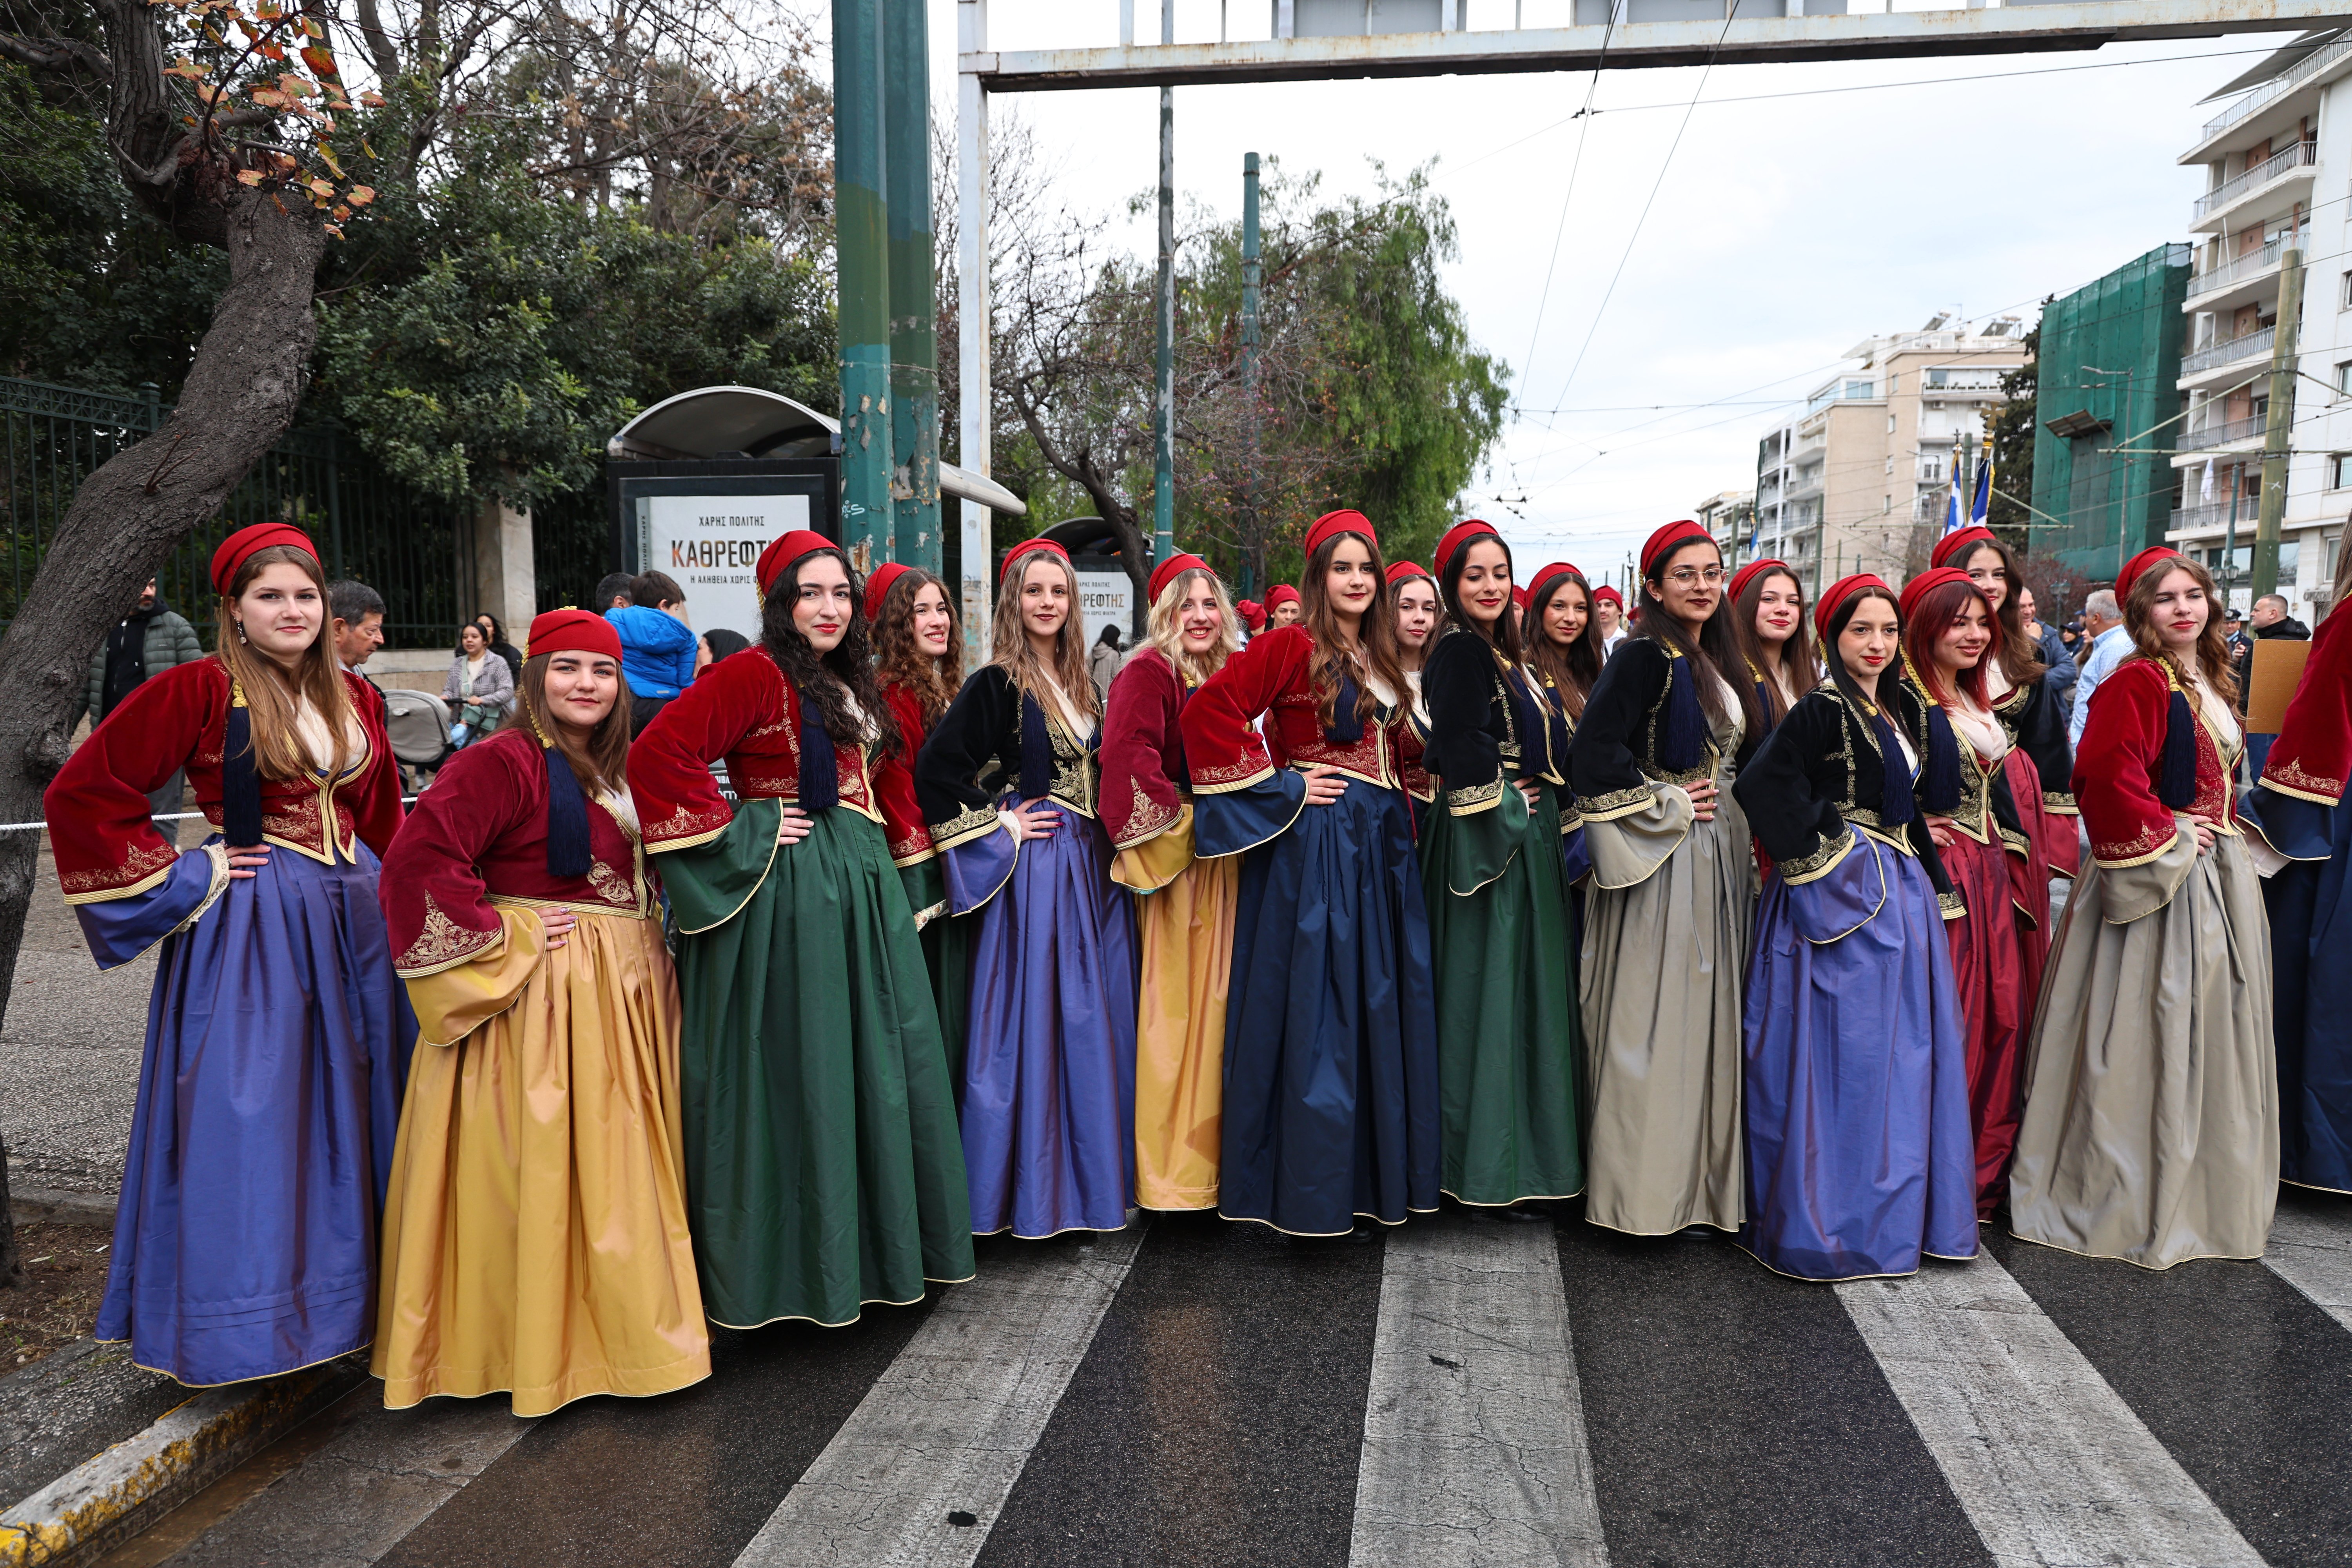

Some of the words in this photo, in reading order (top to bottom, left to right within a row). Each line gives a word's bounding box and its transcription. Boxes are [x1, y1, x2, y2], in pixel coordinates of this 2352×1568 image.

[699, 516, 726, 526] ΧΑΡΗΣ
[729, 515, 765, 526] ΠΟΛΙΤΗΣ
[671, 539, 772, 567] ΚΑΘΡΕΦΤ
[1080, 593, 1124, 607] ΡΕΦΤΗΣ
